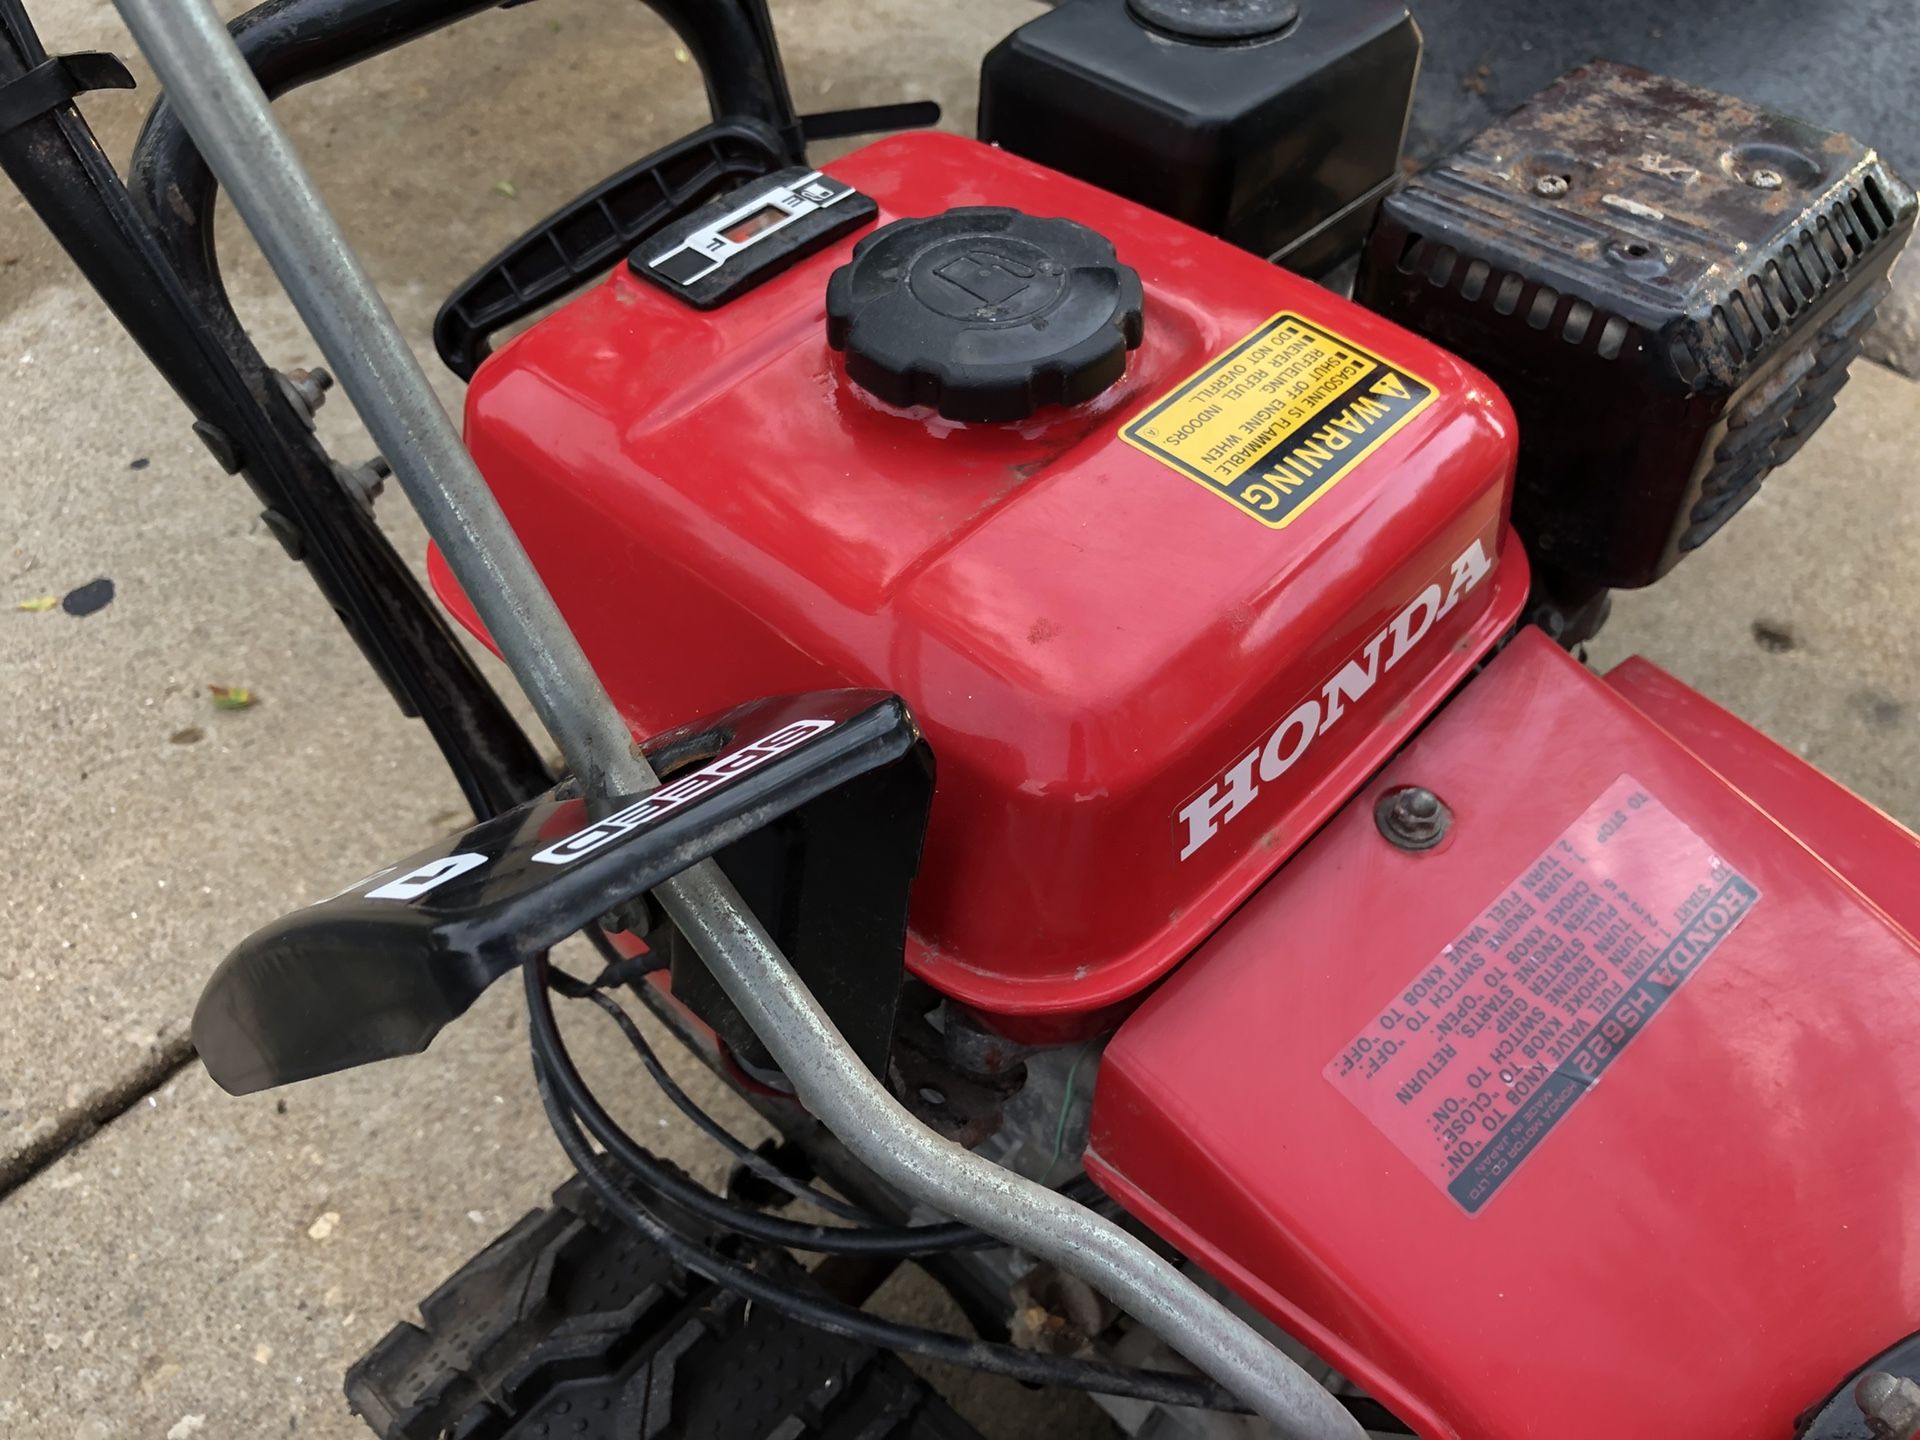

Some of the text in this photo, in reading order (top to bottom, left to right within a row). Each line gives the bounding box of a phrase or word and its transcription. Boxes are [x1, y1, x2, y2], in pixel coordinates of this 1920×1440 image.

[781, 195, 804, 208] E
[706, 237, 727, 252] F
[1187, 330, 1292, 408] DO NOT OVERFILL.
[1256, 346, 1325, 397] REFUELING.
[1161, 338, 1309, 449] NEVER REFUEL INDOORS.
[1199, 355, 1342, 465] SHUT OFF ENGINE WHEN
[1212, 364, 1358, 478] GASOLINE IS FLAMMABLE.
[1236, 392, 1392, 513] WARNING
[1179, 539, 1491, 861] HONDA
[540, 722, 832, 858] SPEED
[1625, 789, 1647, 811] TO
[1591, 808, 1628, 844] STOP
[1518, 852, 1559, 891] TURN
[1533, 863, 1573, 903] TURN
[1708, 862, 1730, 884] TO
[1483, 888, 1522, 926] FUEL
[1543, 878, 1591, 926] CHOKE
[1560, 890, 1604, 934] WHEN
[1582, 902, 1618, 938] PULL
[1670, 881, 1712, 925] START
[1443, 922, 1488, 966] VALVE
[1484, 901, 1536, 953] ENGINE
[1504, 923, 1546, 966] KNOB
[1592, 915, 1631, 955] TURN
[1606, 927, 1645, 968] TURN
[1427, 951, 1486, 1009] SWITCH
[1481, 963, 1507, 989] TO
[1511, 932, 1564, 985] ENGINE
[1526, 936, 1586, 997] STARTER
[1543, 953, 1595, 1007] ENGINE
[1570, 883, 1749, 1078] HONDA HS622
[1619, 939, 1659, 980] TURN
[1401, 963, 1447, 1008] KNOB
[1560, 965, 1609, 1017] CHOKE
[1585, 978, 1623, 1018] FUEL
[1377, 1005, 1405, 1032] TO
[1403, 1007, 1430, 1034] TO
[1487, 995, 1530, 1038] GRIP.
[1488, 1004, 1547, 1065] SWITCH
[1520, 1014, 1564, 1060] KNOB
[1545, 1014, 1590, 1061] VALVE
[1394, 1042, 1458, 1106] RETURN
[1464, 1063, 1491, 1090] TO
[1496, 1058, 1523, 1085] TO
[1503, 1059, 1548, 1107] KNOB
[1479, 1104, 1507, 1133] TO
[1540, 1080, 1578, 1120] HONDA
[1473, 1088, 1553, 1175] MADE IN JAPAN
[1505, 1117, 1544, 1159] MOTOR
